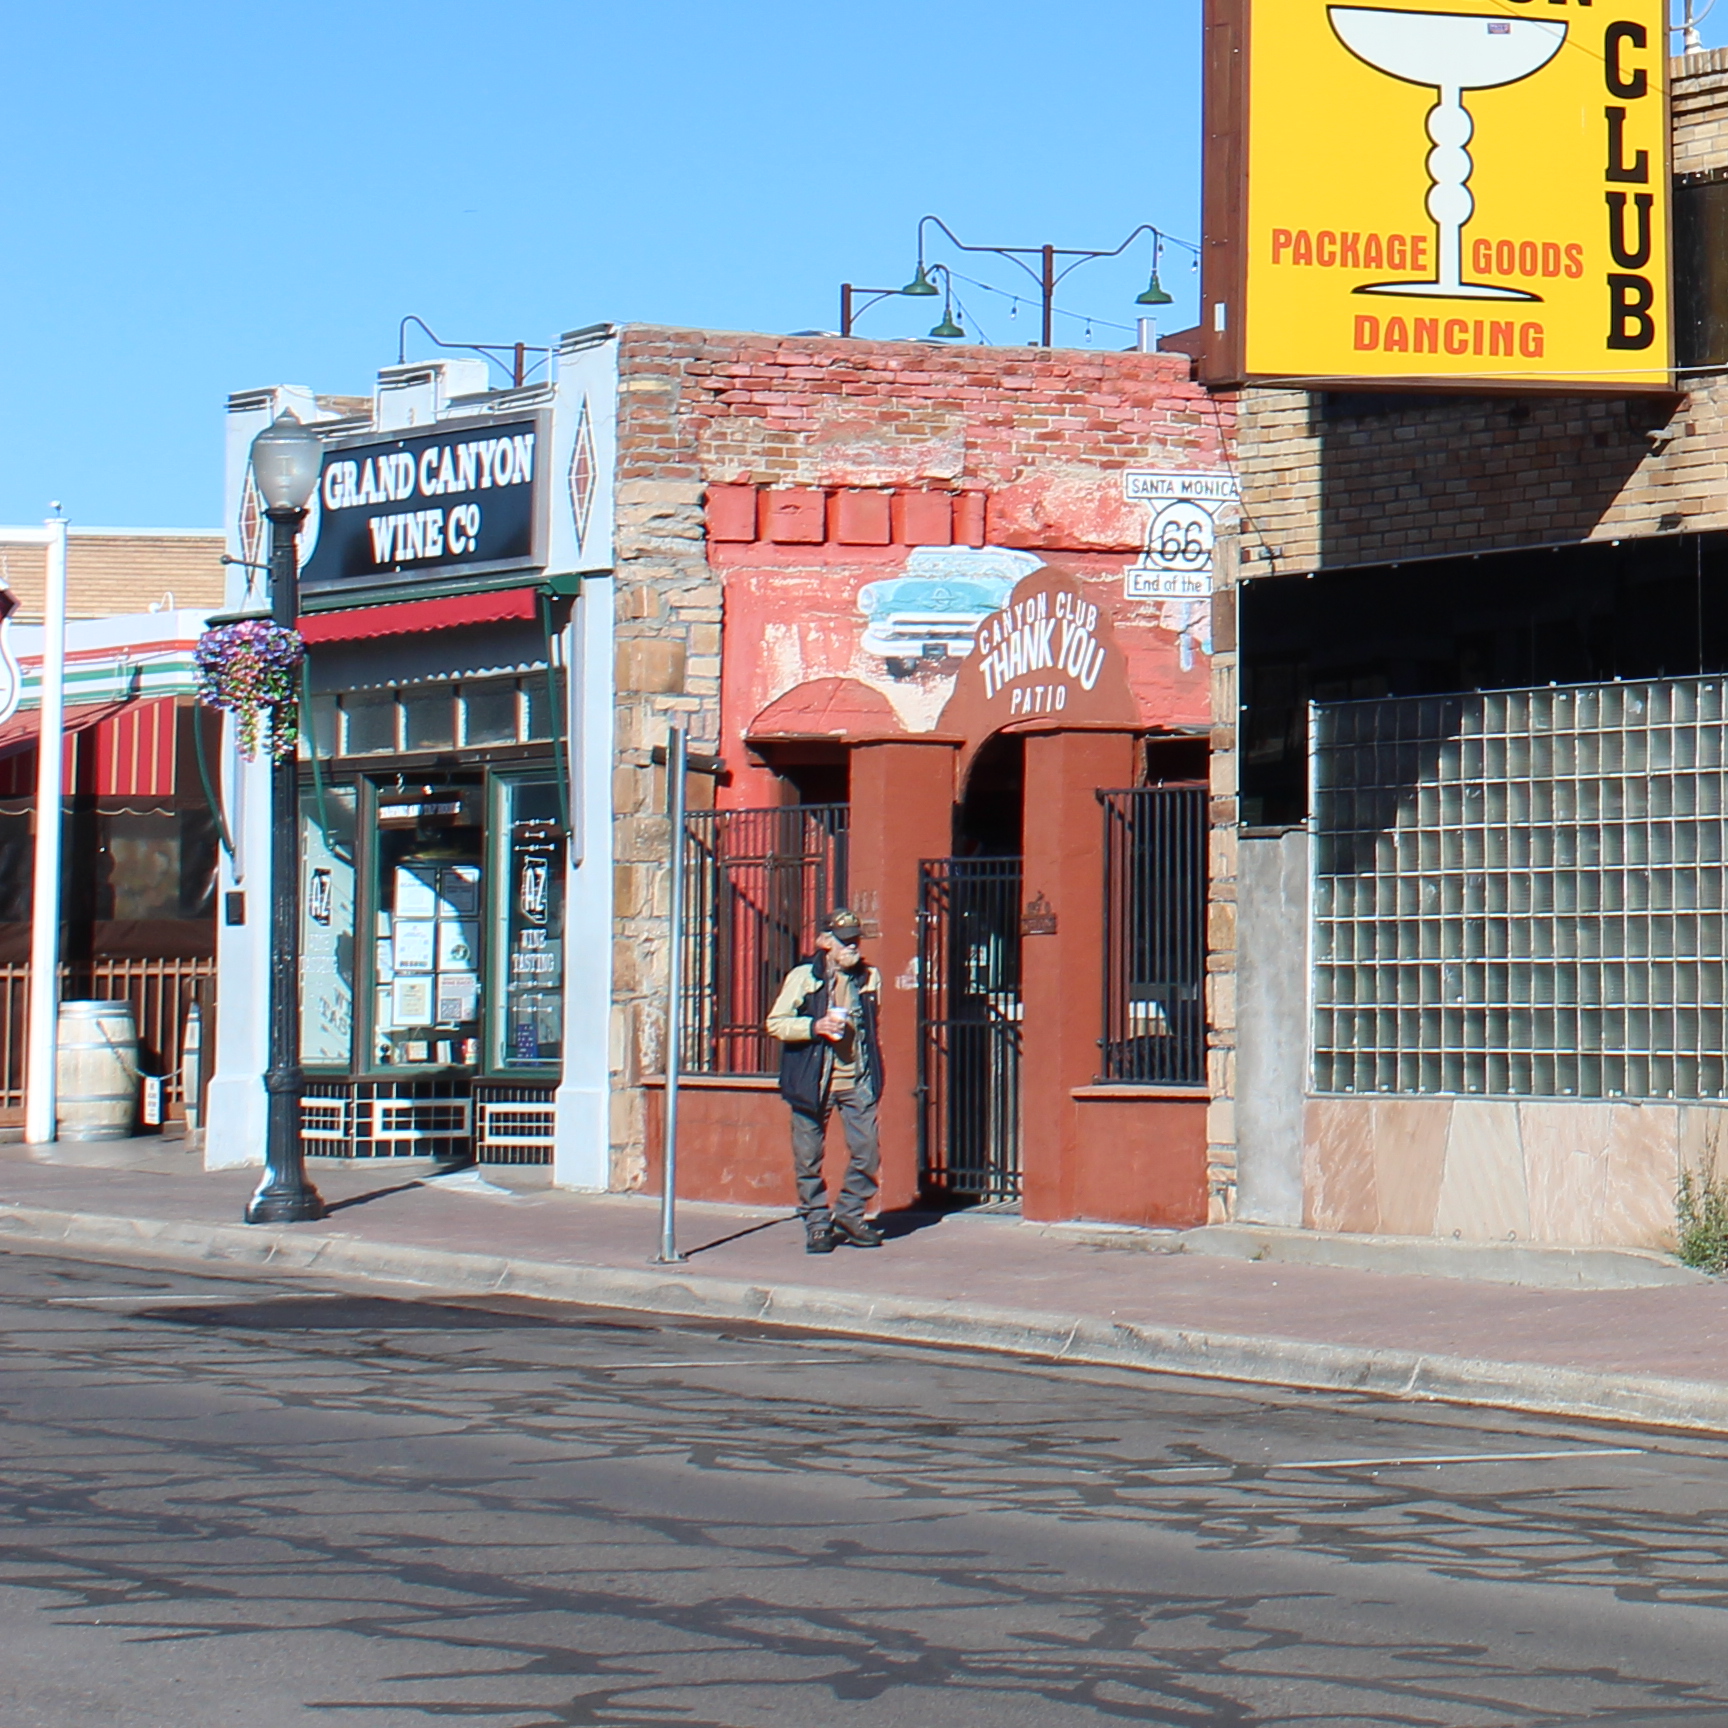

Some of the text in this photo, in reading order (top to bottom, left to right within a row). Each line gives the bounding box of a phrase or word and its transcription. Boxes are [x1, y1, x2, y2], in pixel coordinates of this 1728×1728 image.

[1603, 21, 1656, 352] CLUB
[1271, 228, 1585, 280] PACKAGE GOODS
[1353, 314, 1545, 359] DANCING
[323, 433, 535, 511] GRAND CANYON
[1131, 478, 1239, 498] SANTA MONICA
[369, 508, 442, 564] WINE
[1161, 520, 1202, 562] 66
[1133, 574, 1160, 591] End
[1164, 575, 1177, 592] of
[1181, 576, 1202, 593] the
[978, 590, 1099, 656] CANYON CLUB
[978, 617, 1105, 700] THANK YOU
[1010, 684, 1066, 715] PATIO
[524, 868, 547, 913] AZ
[519, 928, 547, 949] WINE
[511, 953, 555, 973] TASTING
